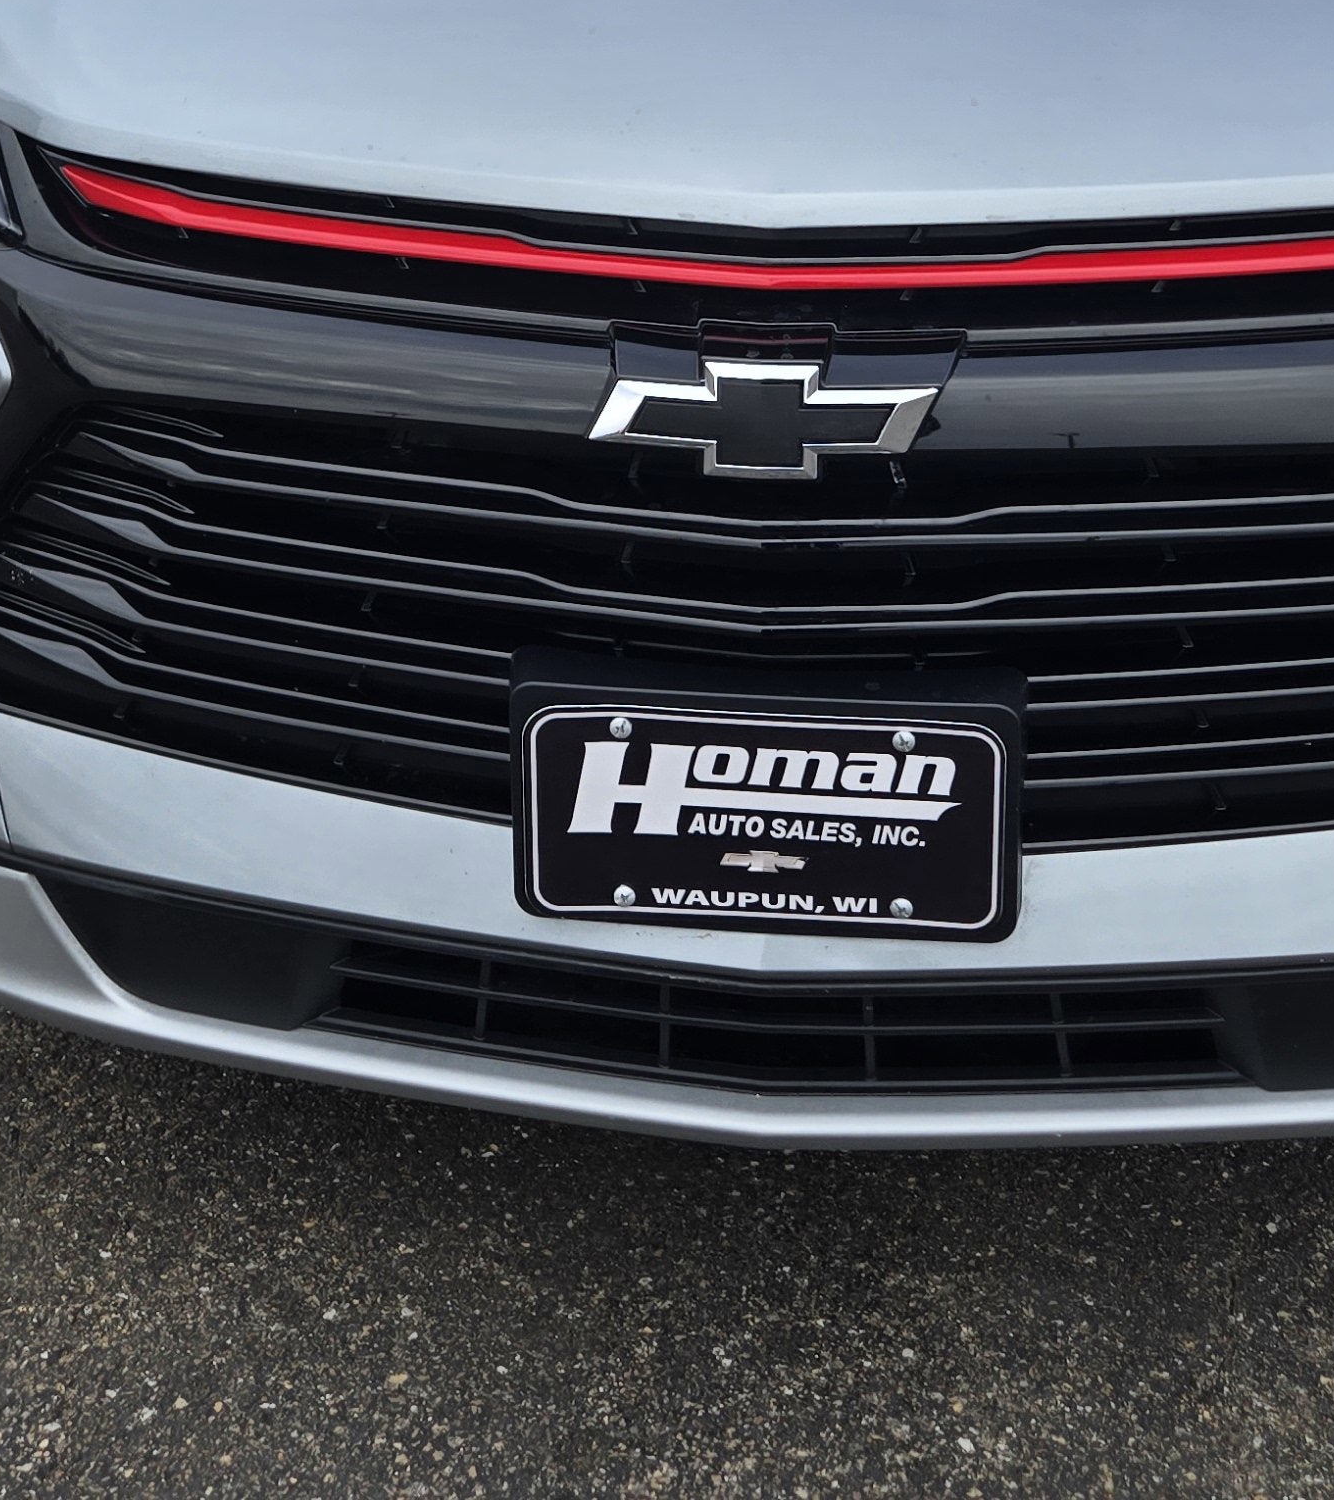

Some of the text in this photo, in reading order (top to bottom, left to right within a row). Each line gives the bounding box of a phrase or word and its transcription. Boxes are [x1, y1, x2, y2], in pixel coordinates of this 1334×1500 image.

[567, 740, 959, 836] Homan
[687, 812, 927, 848] AUTO SALES, INC.
[651, 887, 878, 914] WAUPUN, WI
